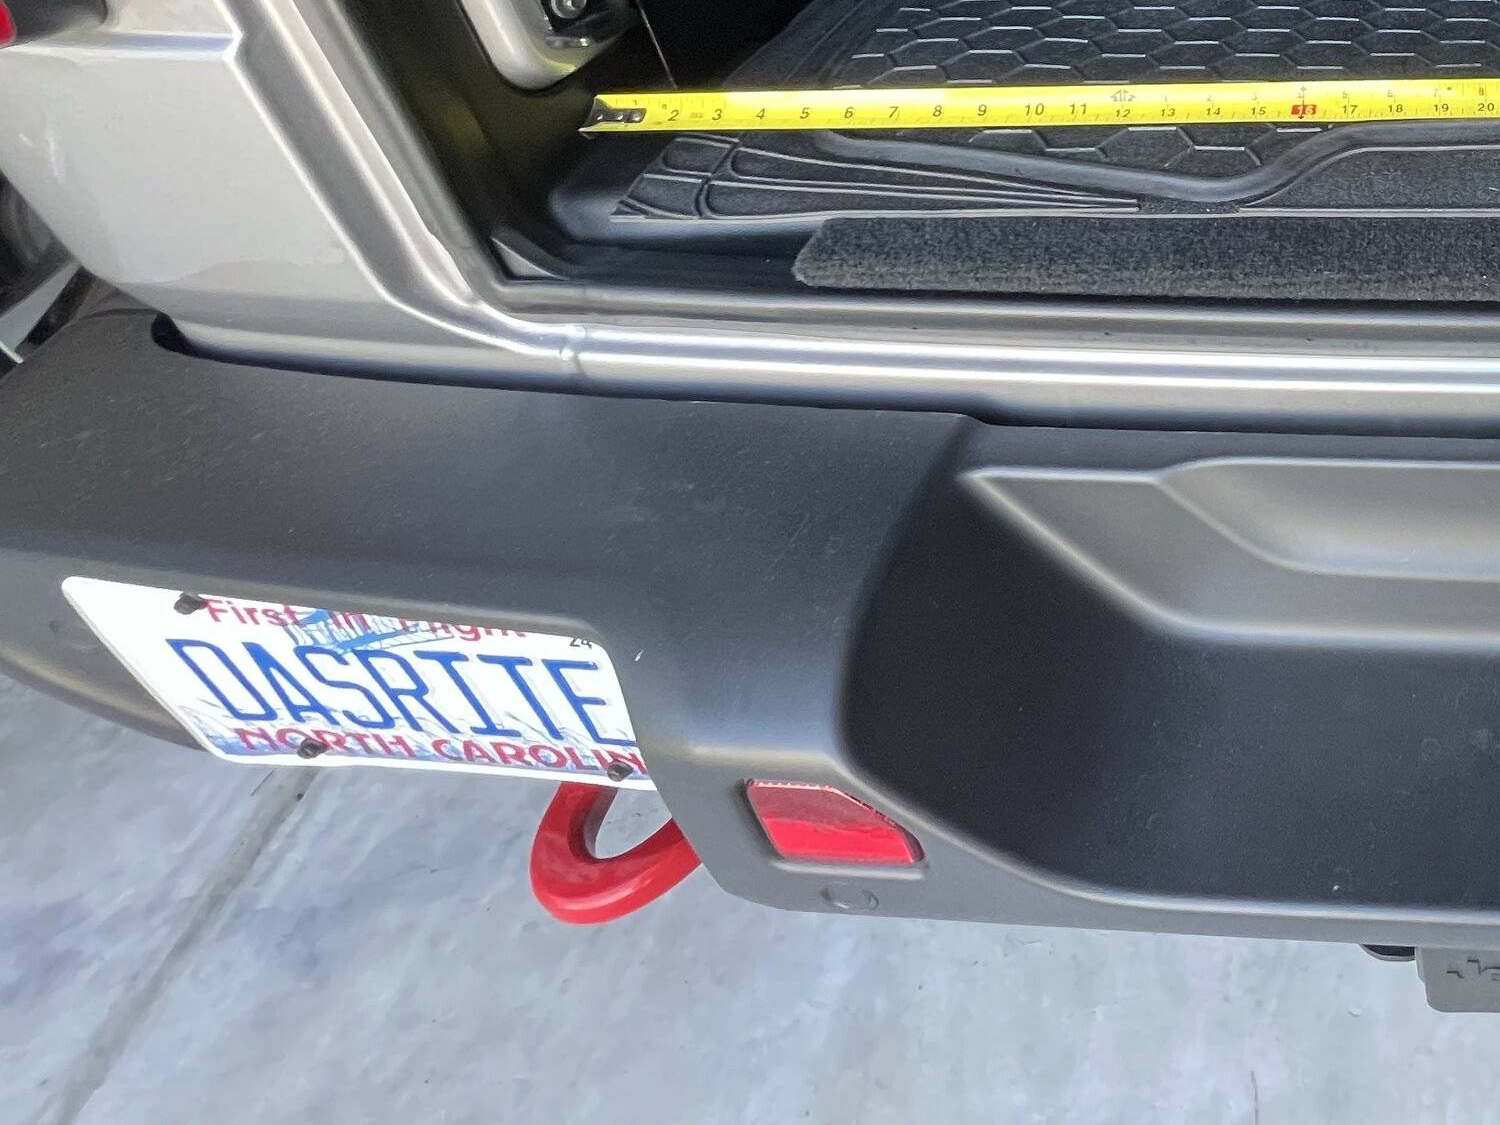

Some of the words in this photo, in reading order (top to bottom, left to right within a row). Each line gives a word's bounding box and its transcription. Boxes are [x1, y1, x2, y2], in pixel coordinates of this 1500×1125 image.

[668, 109, 680, 122] 2
[711, 108, 723, 121] 3
[755, 108, 766, 120] 4
[799, 107, 810, 119] 5
[844, 106, 854, 119] 6
[888, 106, 899, 118] 7
[932, 104, 942, 117] 8
[977, 104, 987, 116] 9
[1024, 103, 1045, 116] 10
[1069, 103, 1087, 116] 11
[1115, 108, 1131, 118] 12
[1160, 107, 1176, 117] 13
[1206, 106, 1221, 116] 14
[1251, 106, 1267, 116] 15
[1297, 106, 1313, 115] 16
[1342, 104, 1358, 114] 17
[1388, 104, 1404, 114] 18
[1433, 103, 1449, 113] 19
[1477, 102, 1495, 112] 20
[206, 598, 300, 626] First
[166, 638, 636, 747] DASRITE
[234, 727, 417, 758] NORTH
[431, 738, 649, 775] CAROLIN
